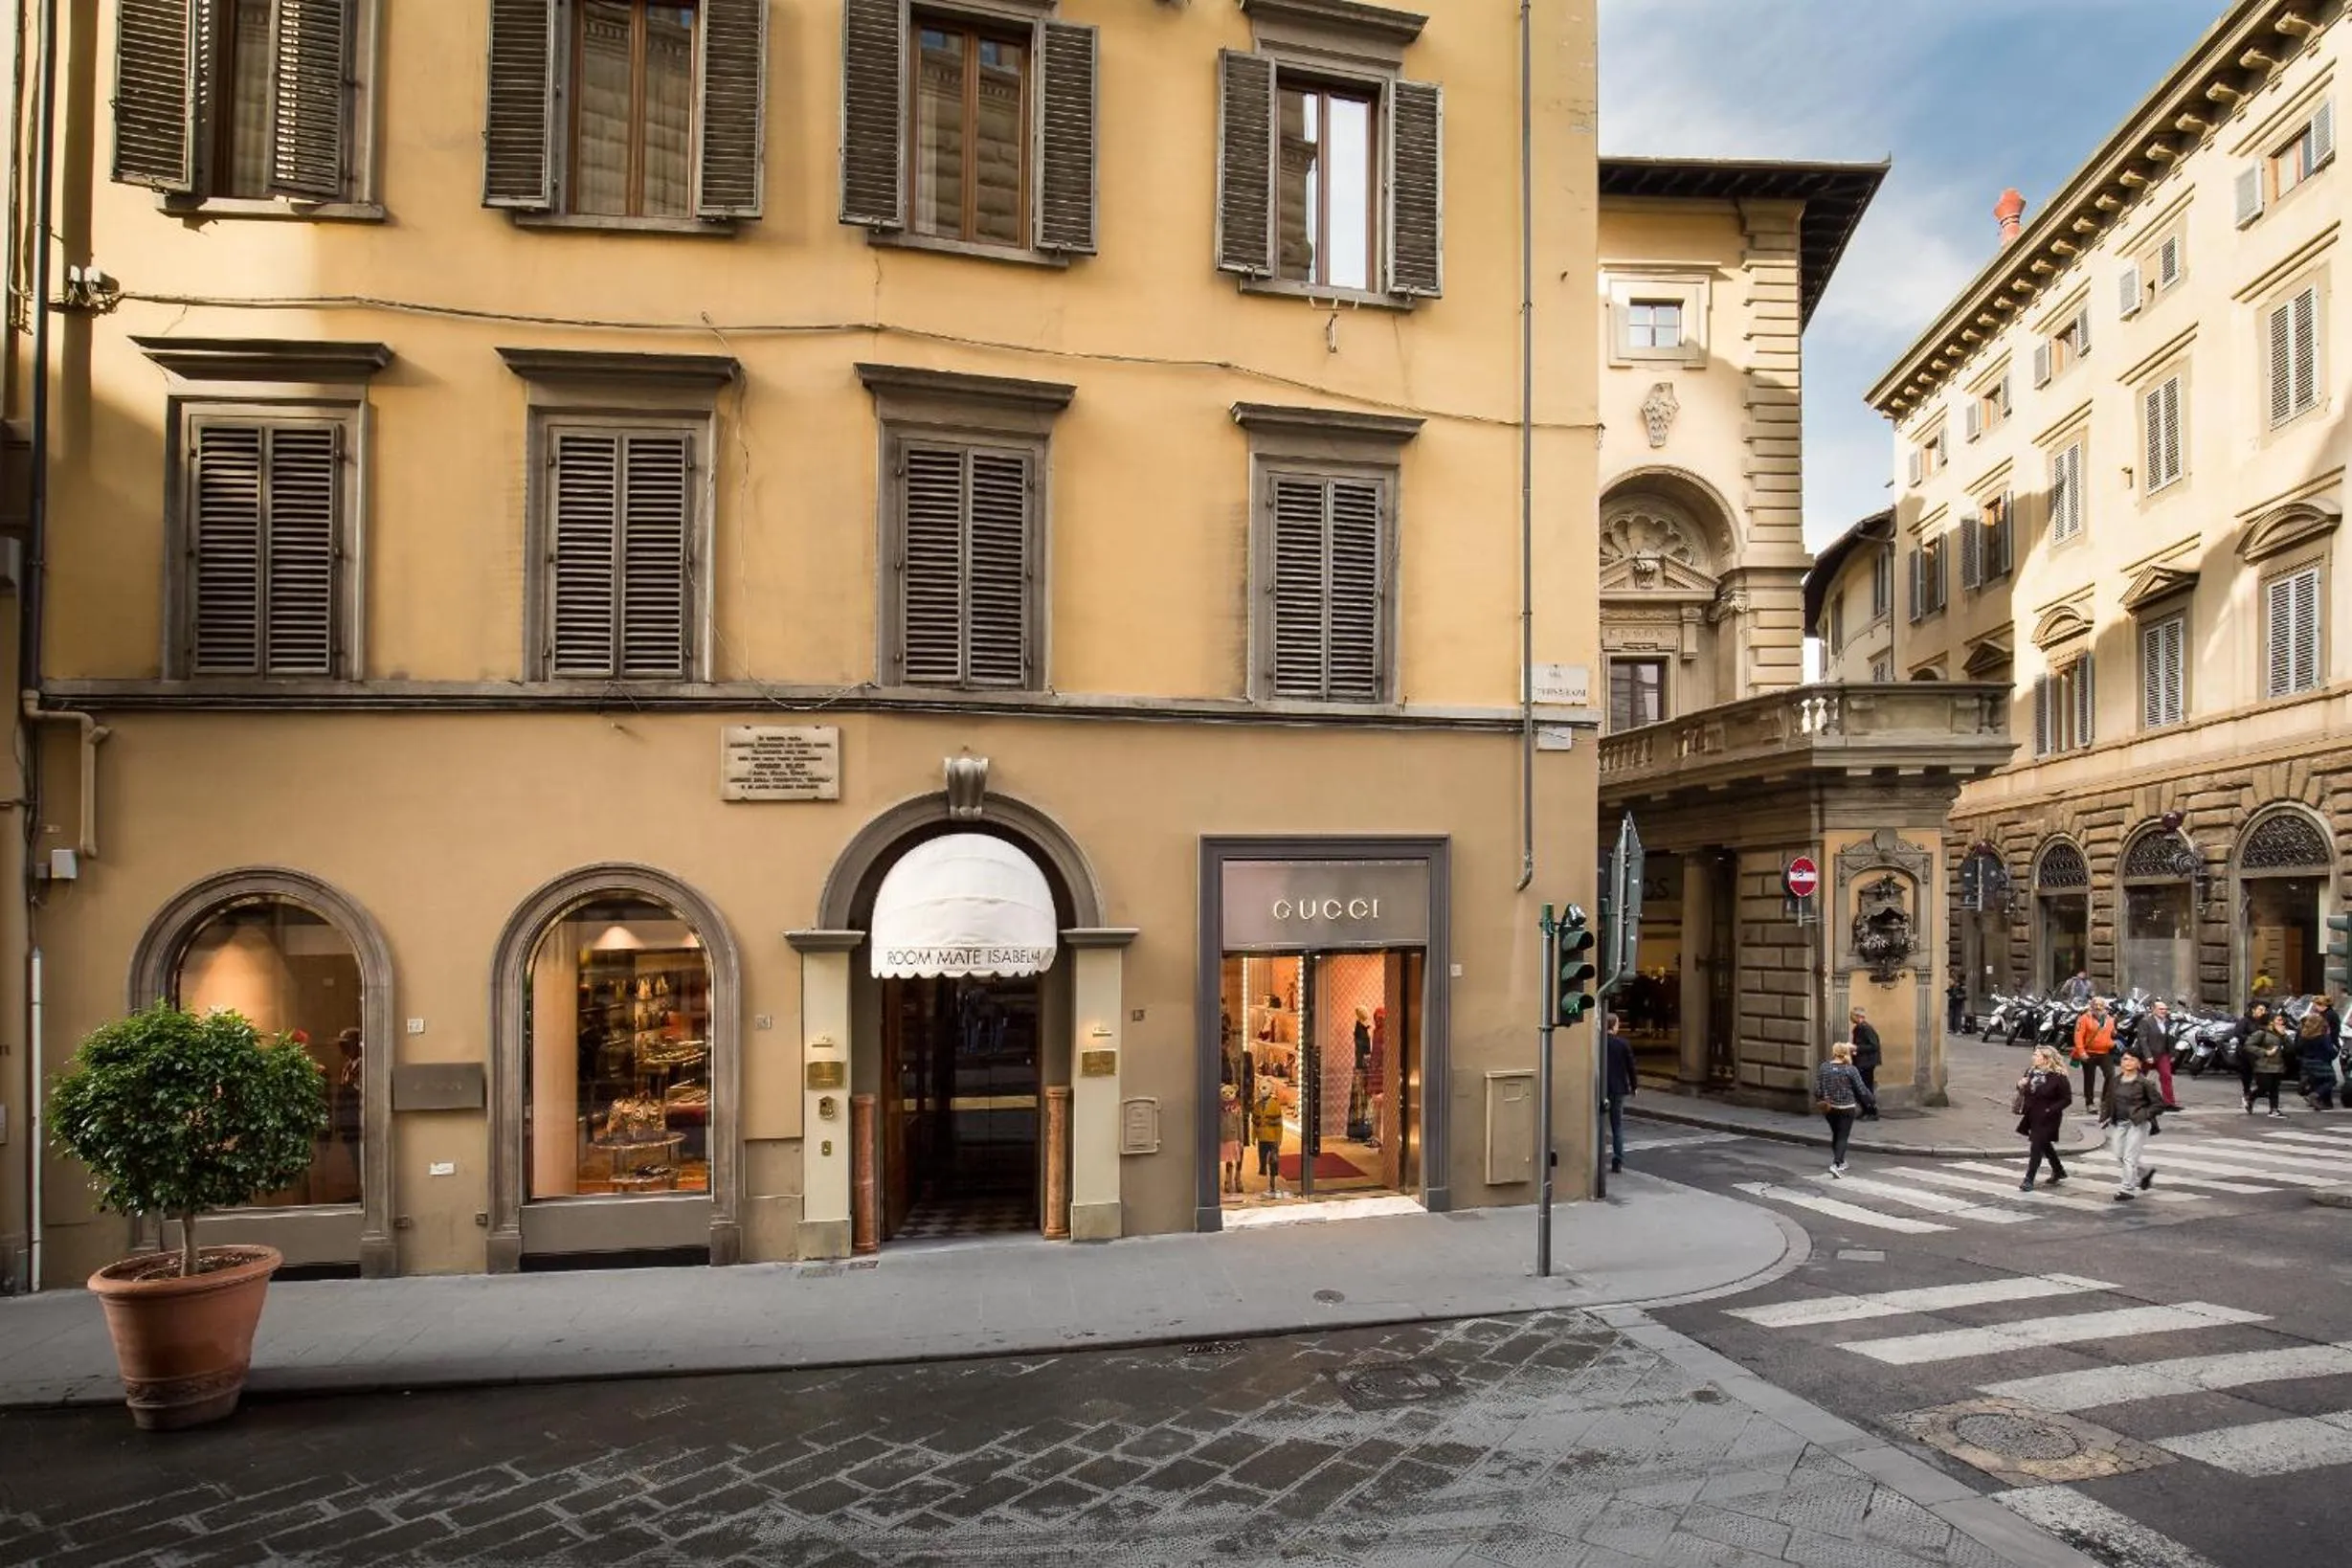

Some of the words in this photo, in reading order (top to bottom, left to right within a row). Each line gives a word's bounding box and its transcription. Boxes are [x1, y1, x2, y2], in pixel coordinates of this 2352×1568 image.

[1273, 898, 1379, 920] GUCCI
[886, 950, 931, 965] ROOM
[936, 949, 981, 965] MATE
